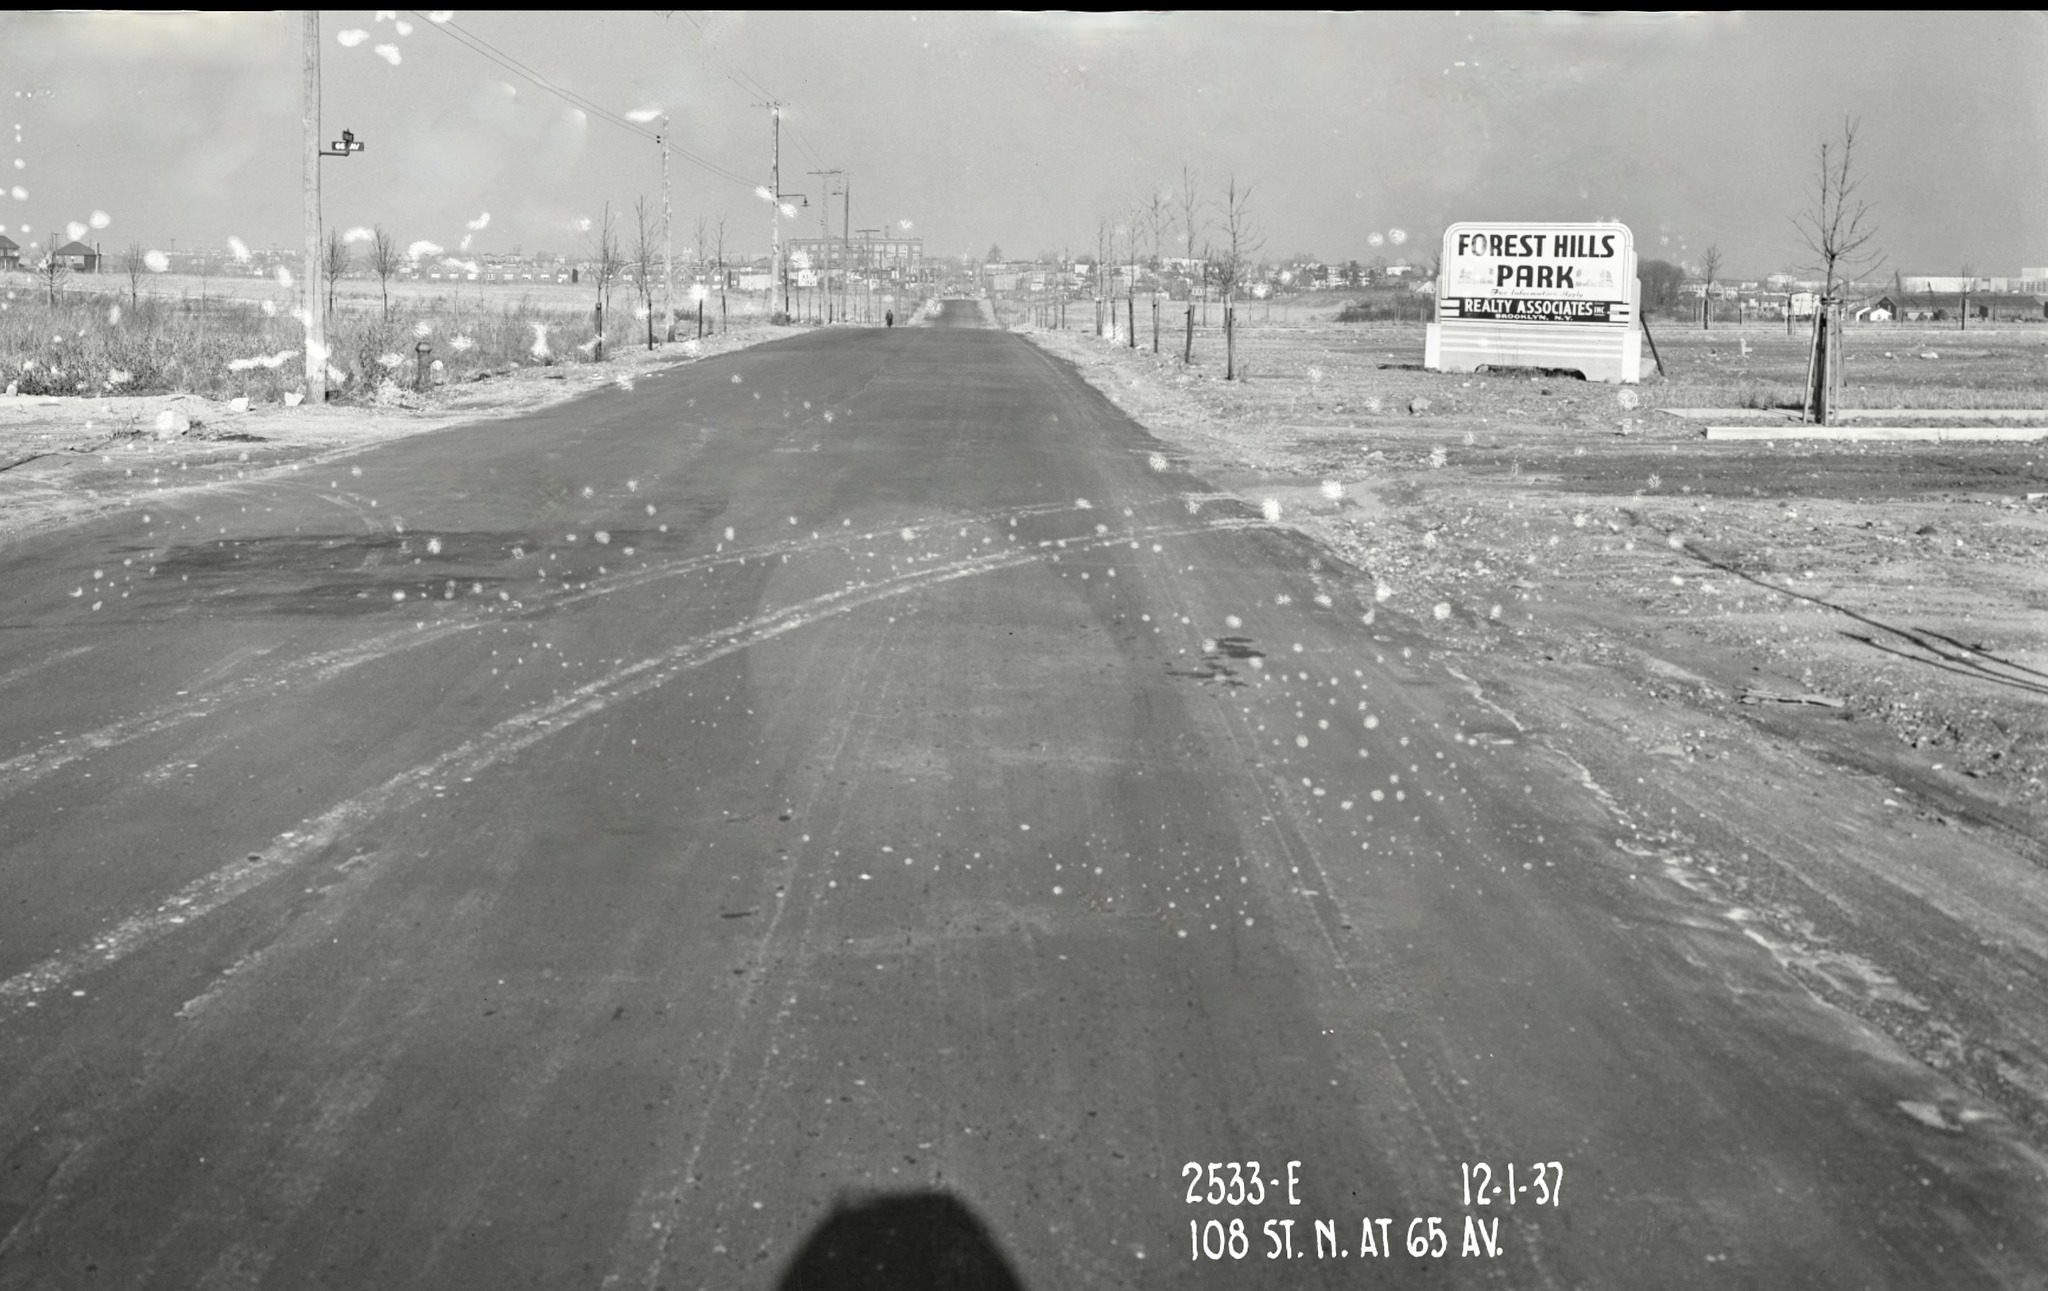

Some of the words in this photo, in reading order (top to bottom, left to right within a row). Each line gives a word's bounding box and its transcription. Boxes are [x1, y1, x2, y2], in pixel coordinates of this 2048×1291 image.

[1458, 234, 1546, 257] FOREST
[1554, 235, 1615, 258] HILLS
[1497, 265, 1574, 288] PARK
[1465, 299, 1512, 313] REALTY
[1517, 300, 1593, 316] ASSOCIATES
